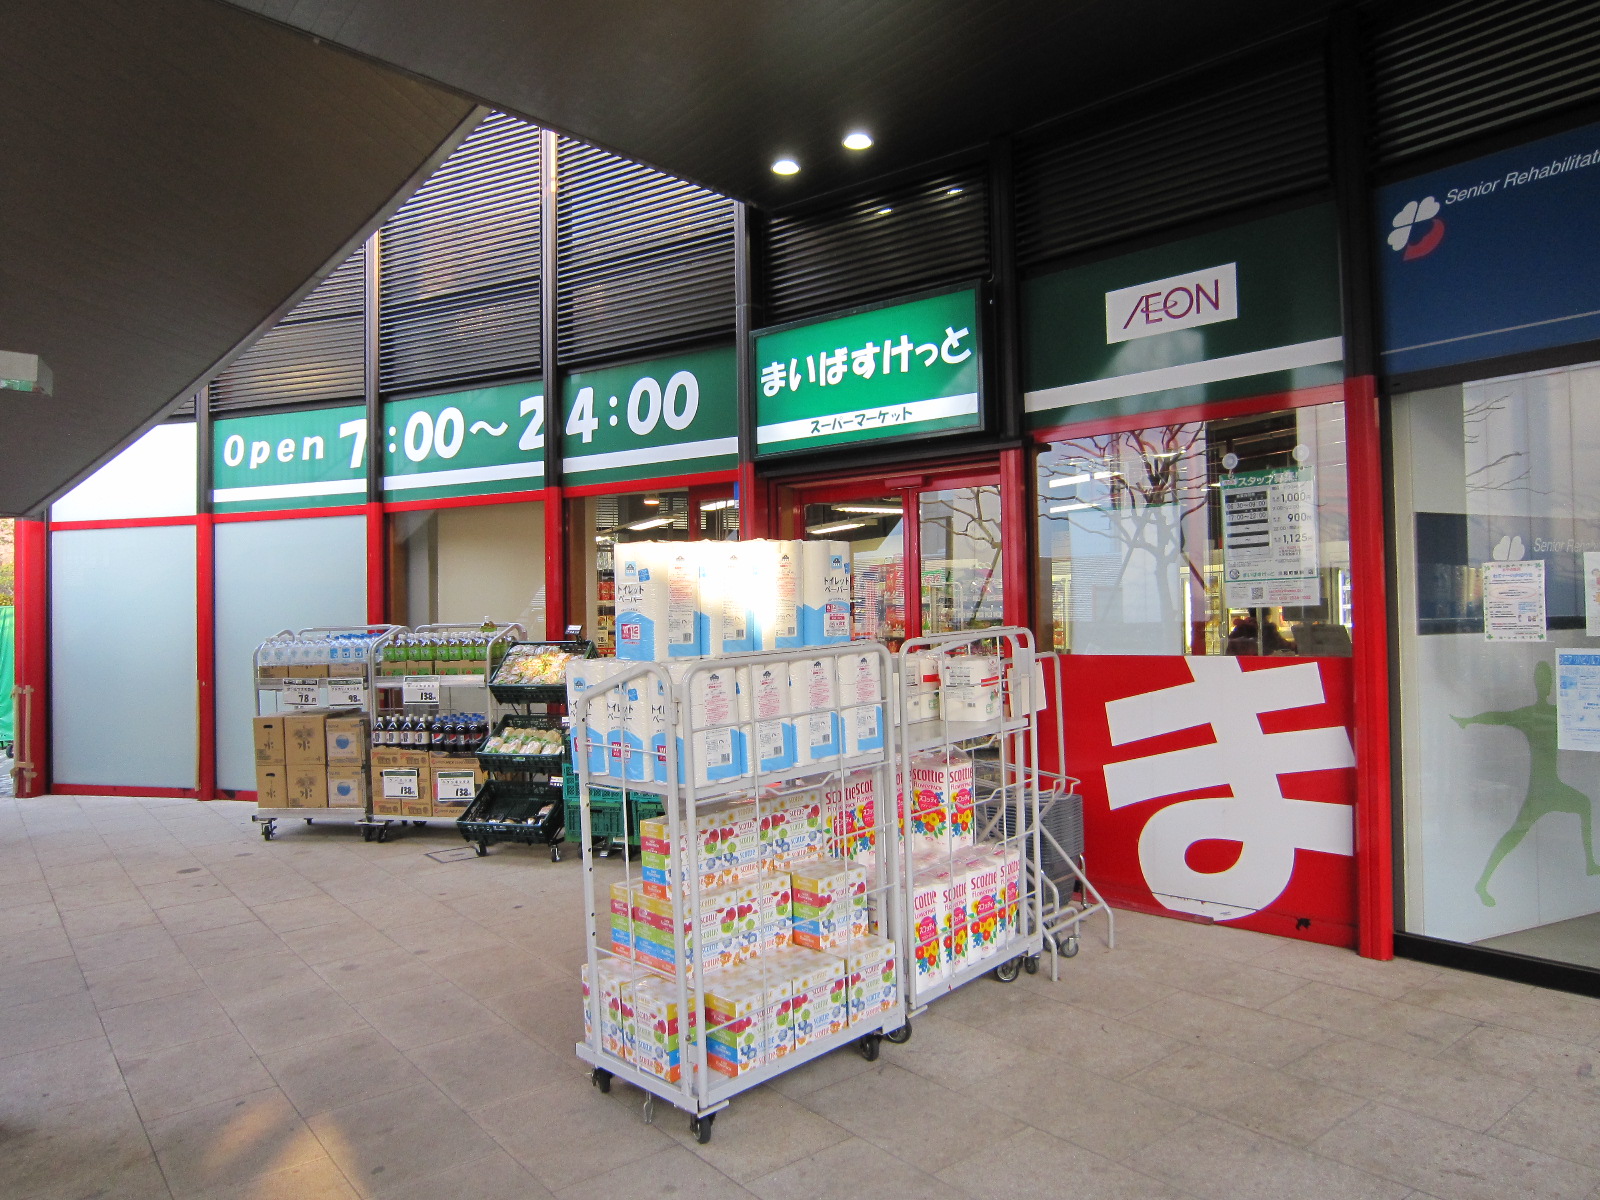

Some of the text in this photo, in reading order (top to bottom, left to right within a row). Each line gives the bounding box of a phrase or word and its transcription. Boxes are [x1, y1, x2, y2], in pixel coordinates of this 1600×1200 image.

[1445, 180, 1500, 204] Senior
[760, 326, 972, 397] まいばすけっと
[810, 406, 912, 434] スーパーマーケット
[223, 434, 324, 470] Open
[617, 584, 645, 595] トイレット
[824, 576, 849, 586] トイレット
[824, 585, 849, 593] ペーパー
[618, 595, 643, 603] ペーパー
[1102, 656, 1356, 922] ま
